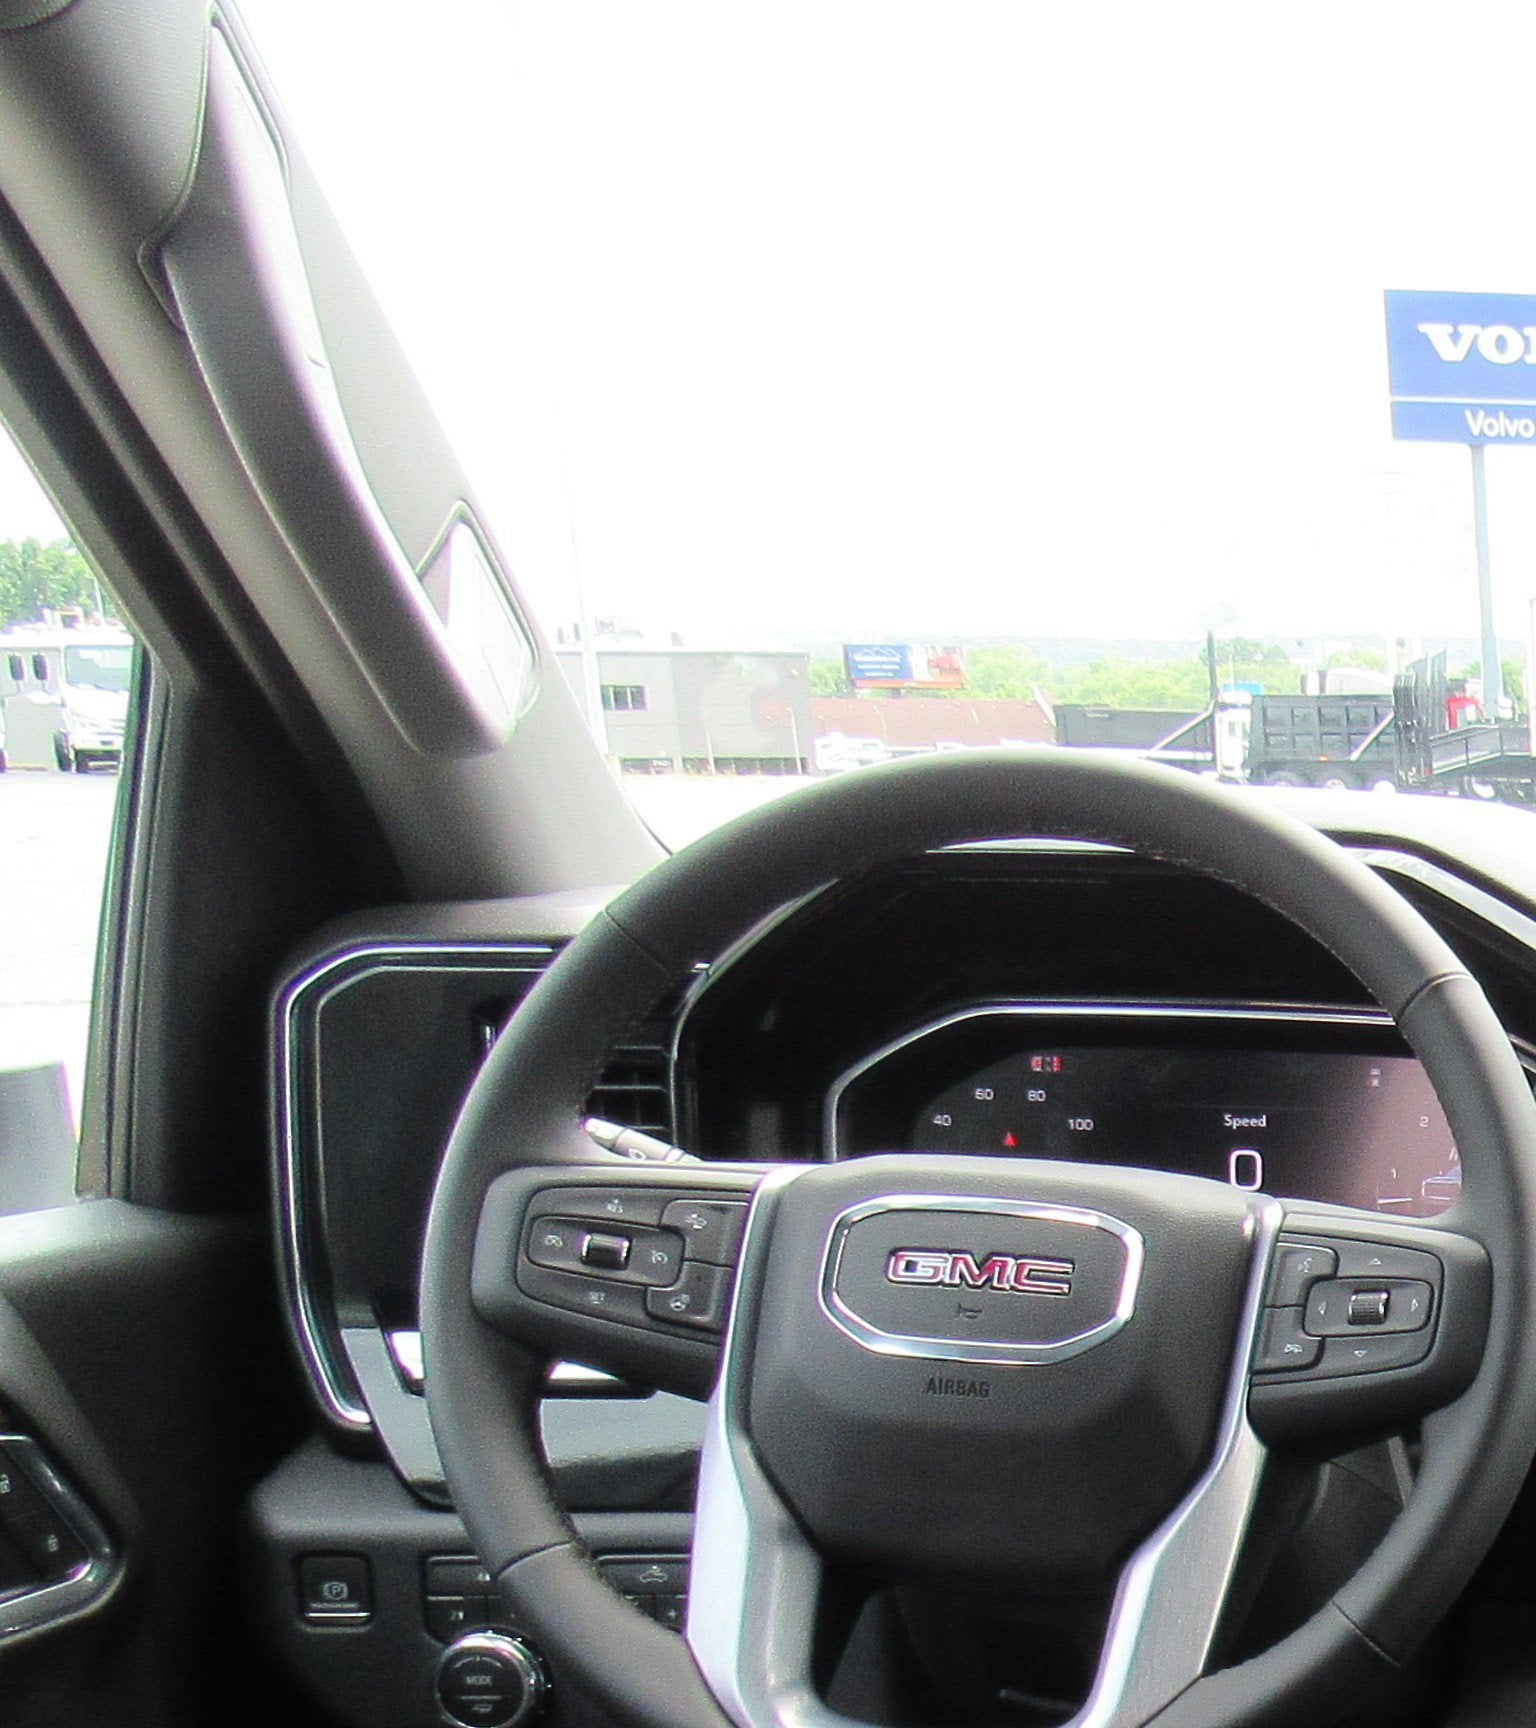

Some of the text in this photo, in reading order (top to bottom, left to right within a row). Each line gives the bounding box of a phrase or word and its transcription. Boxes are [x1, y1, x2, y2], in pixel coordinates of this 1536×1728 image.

[1464, 408, 1536, 439] Volvo
[974, 1088, 995, 1101] 60
[1027, 1090, 1047, 1102] 80
[933, 1114, 952, 1126] 40
[1067, 1118, 1094, 1131] 100
[1223, 1114, 1267, 1130] Speed
[885, 1247, 1075, 1296] GMC
[925, 1376, 991, 1399] AIRBAG
